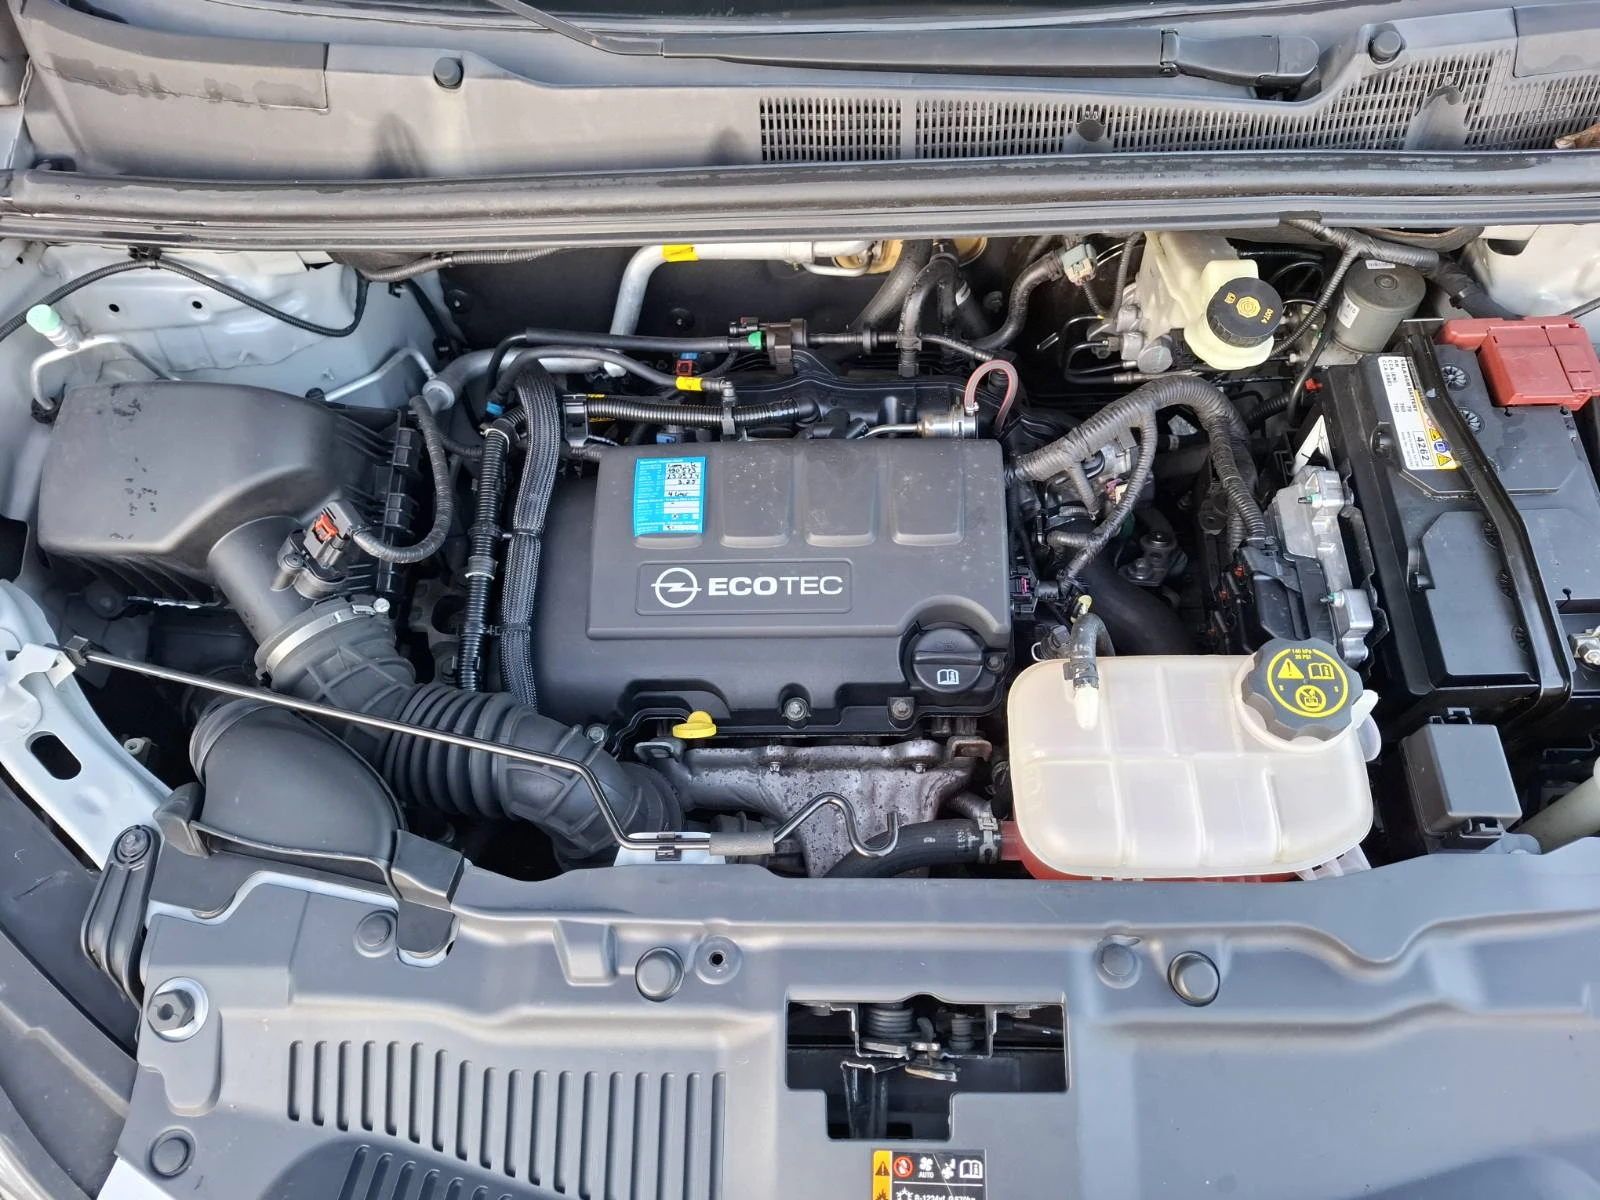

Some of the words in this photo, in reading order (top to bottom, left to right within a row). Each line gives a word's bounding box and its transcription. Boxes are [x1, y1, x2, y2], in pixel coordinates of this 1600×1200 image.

[1417, 437, 1430, 461] 4262
[708, 576, 843, 596] ECOTEC
[918, 1171, 935, 1179] AUTO
